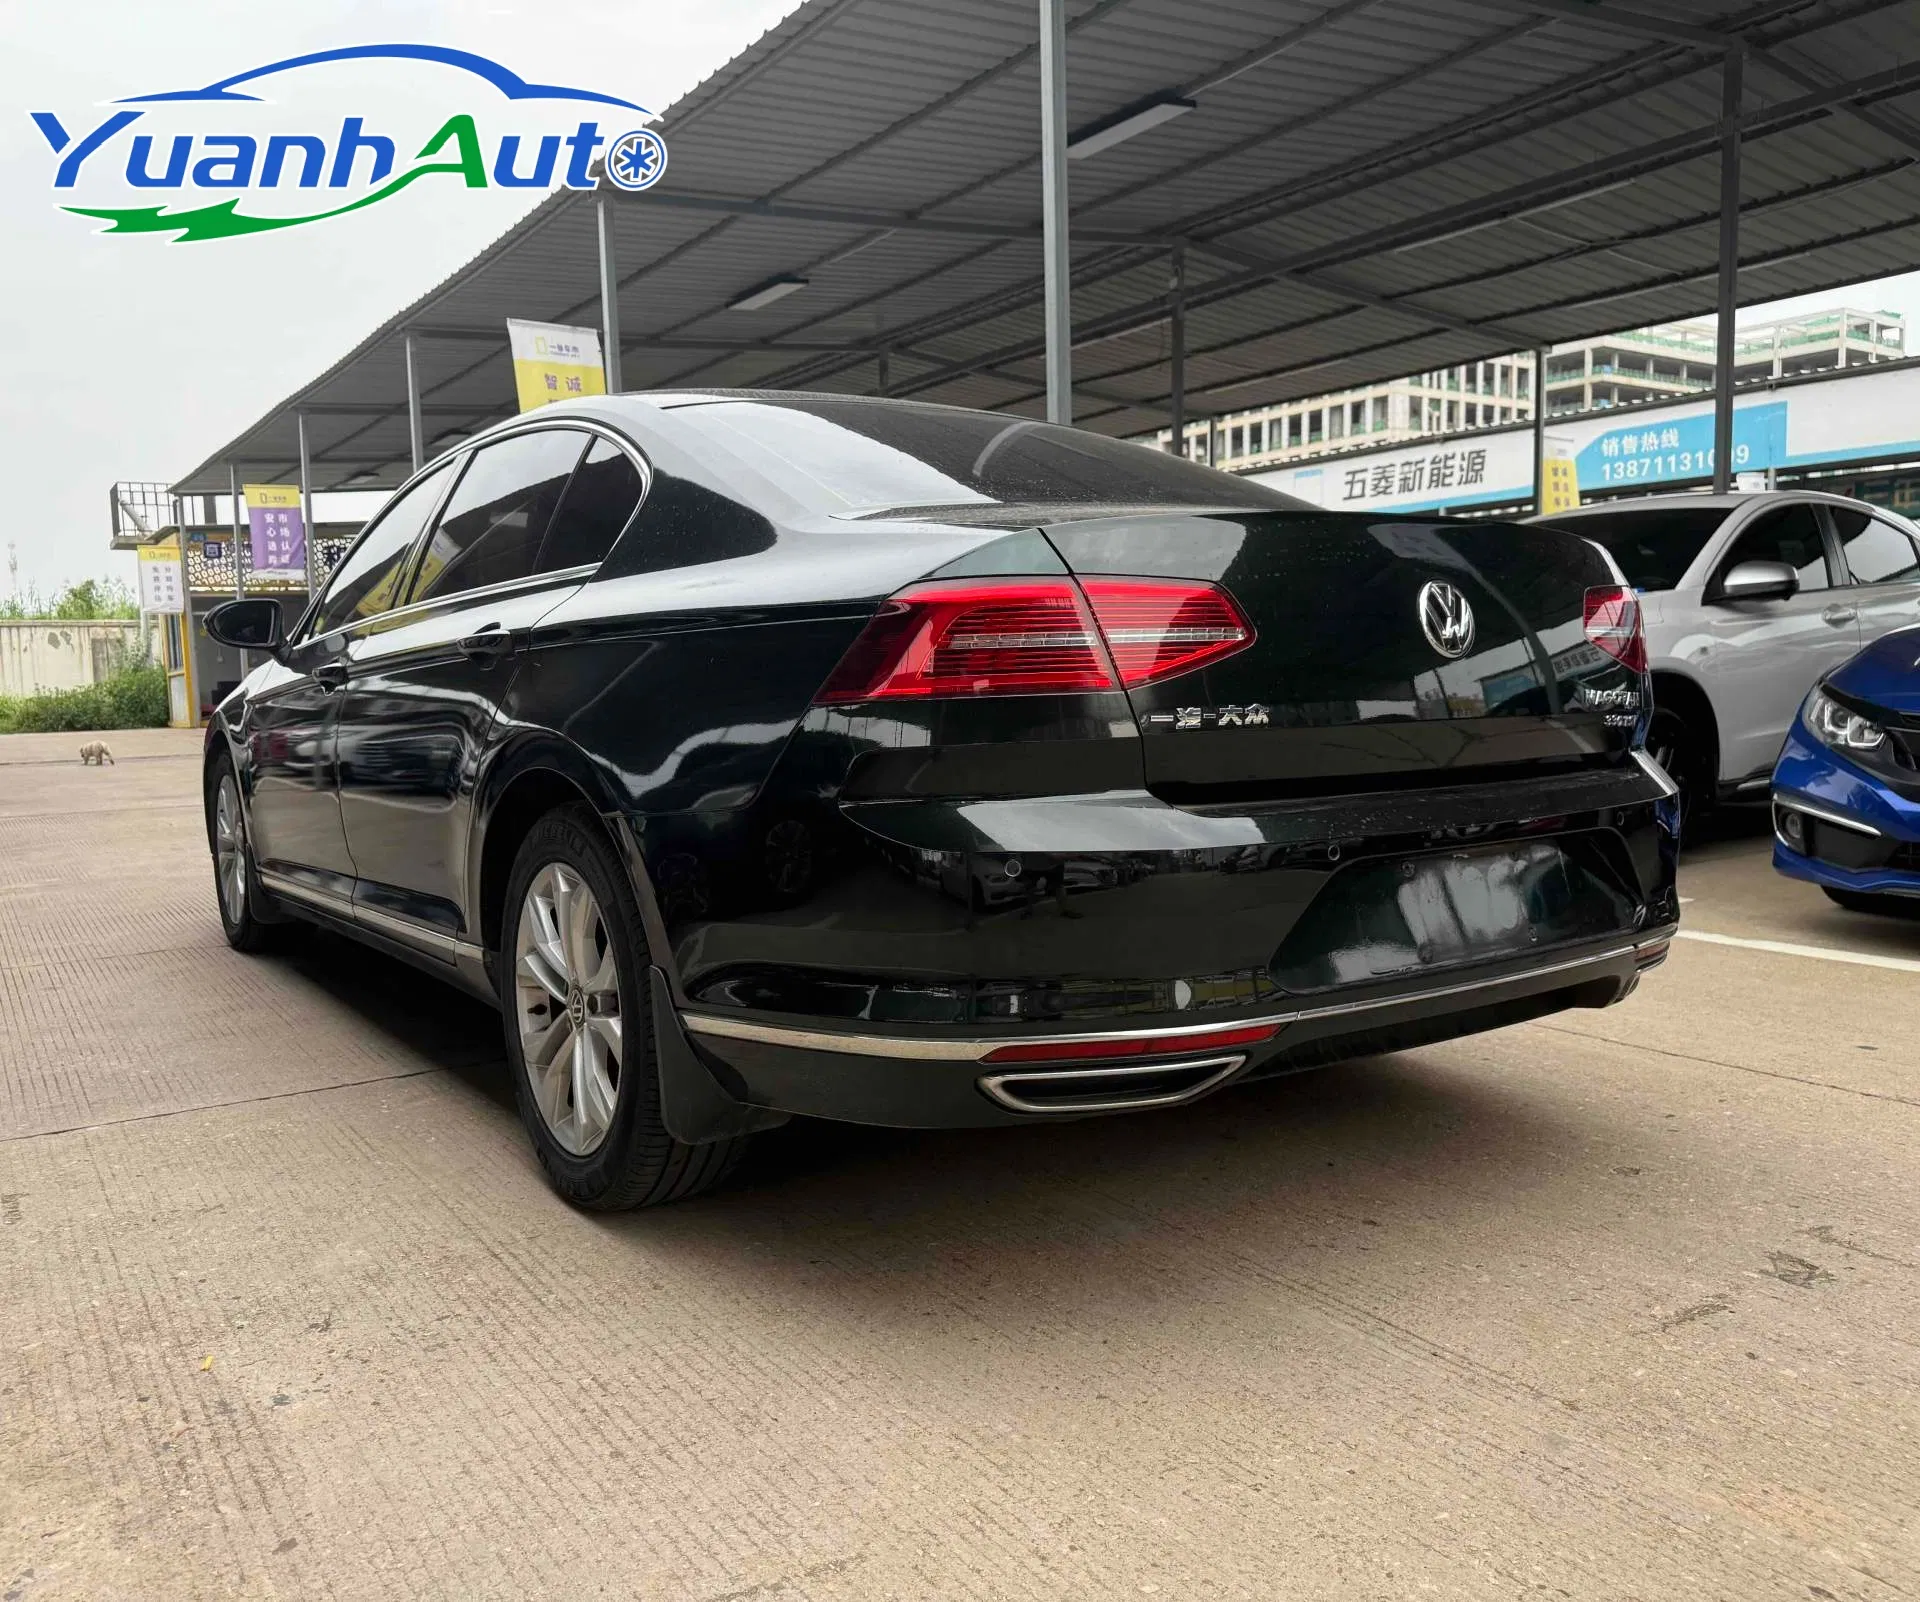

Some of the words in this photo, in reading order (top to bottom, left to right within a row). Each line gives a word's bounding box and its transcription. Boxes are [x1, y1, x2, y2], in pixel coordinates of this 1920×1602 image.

[1602, 428, 1680, 457] 销售热线
[1342, 448, 1487, 501] 五菱新能源
[1602, 444, 1750, 481] 138711319
